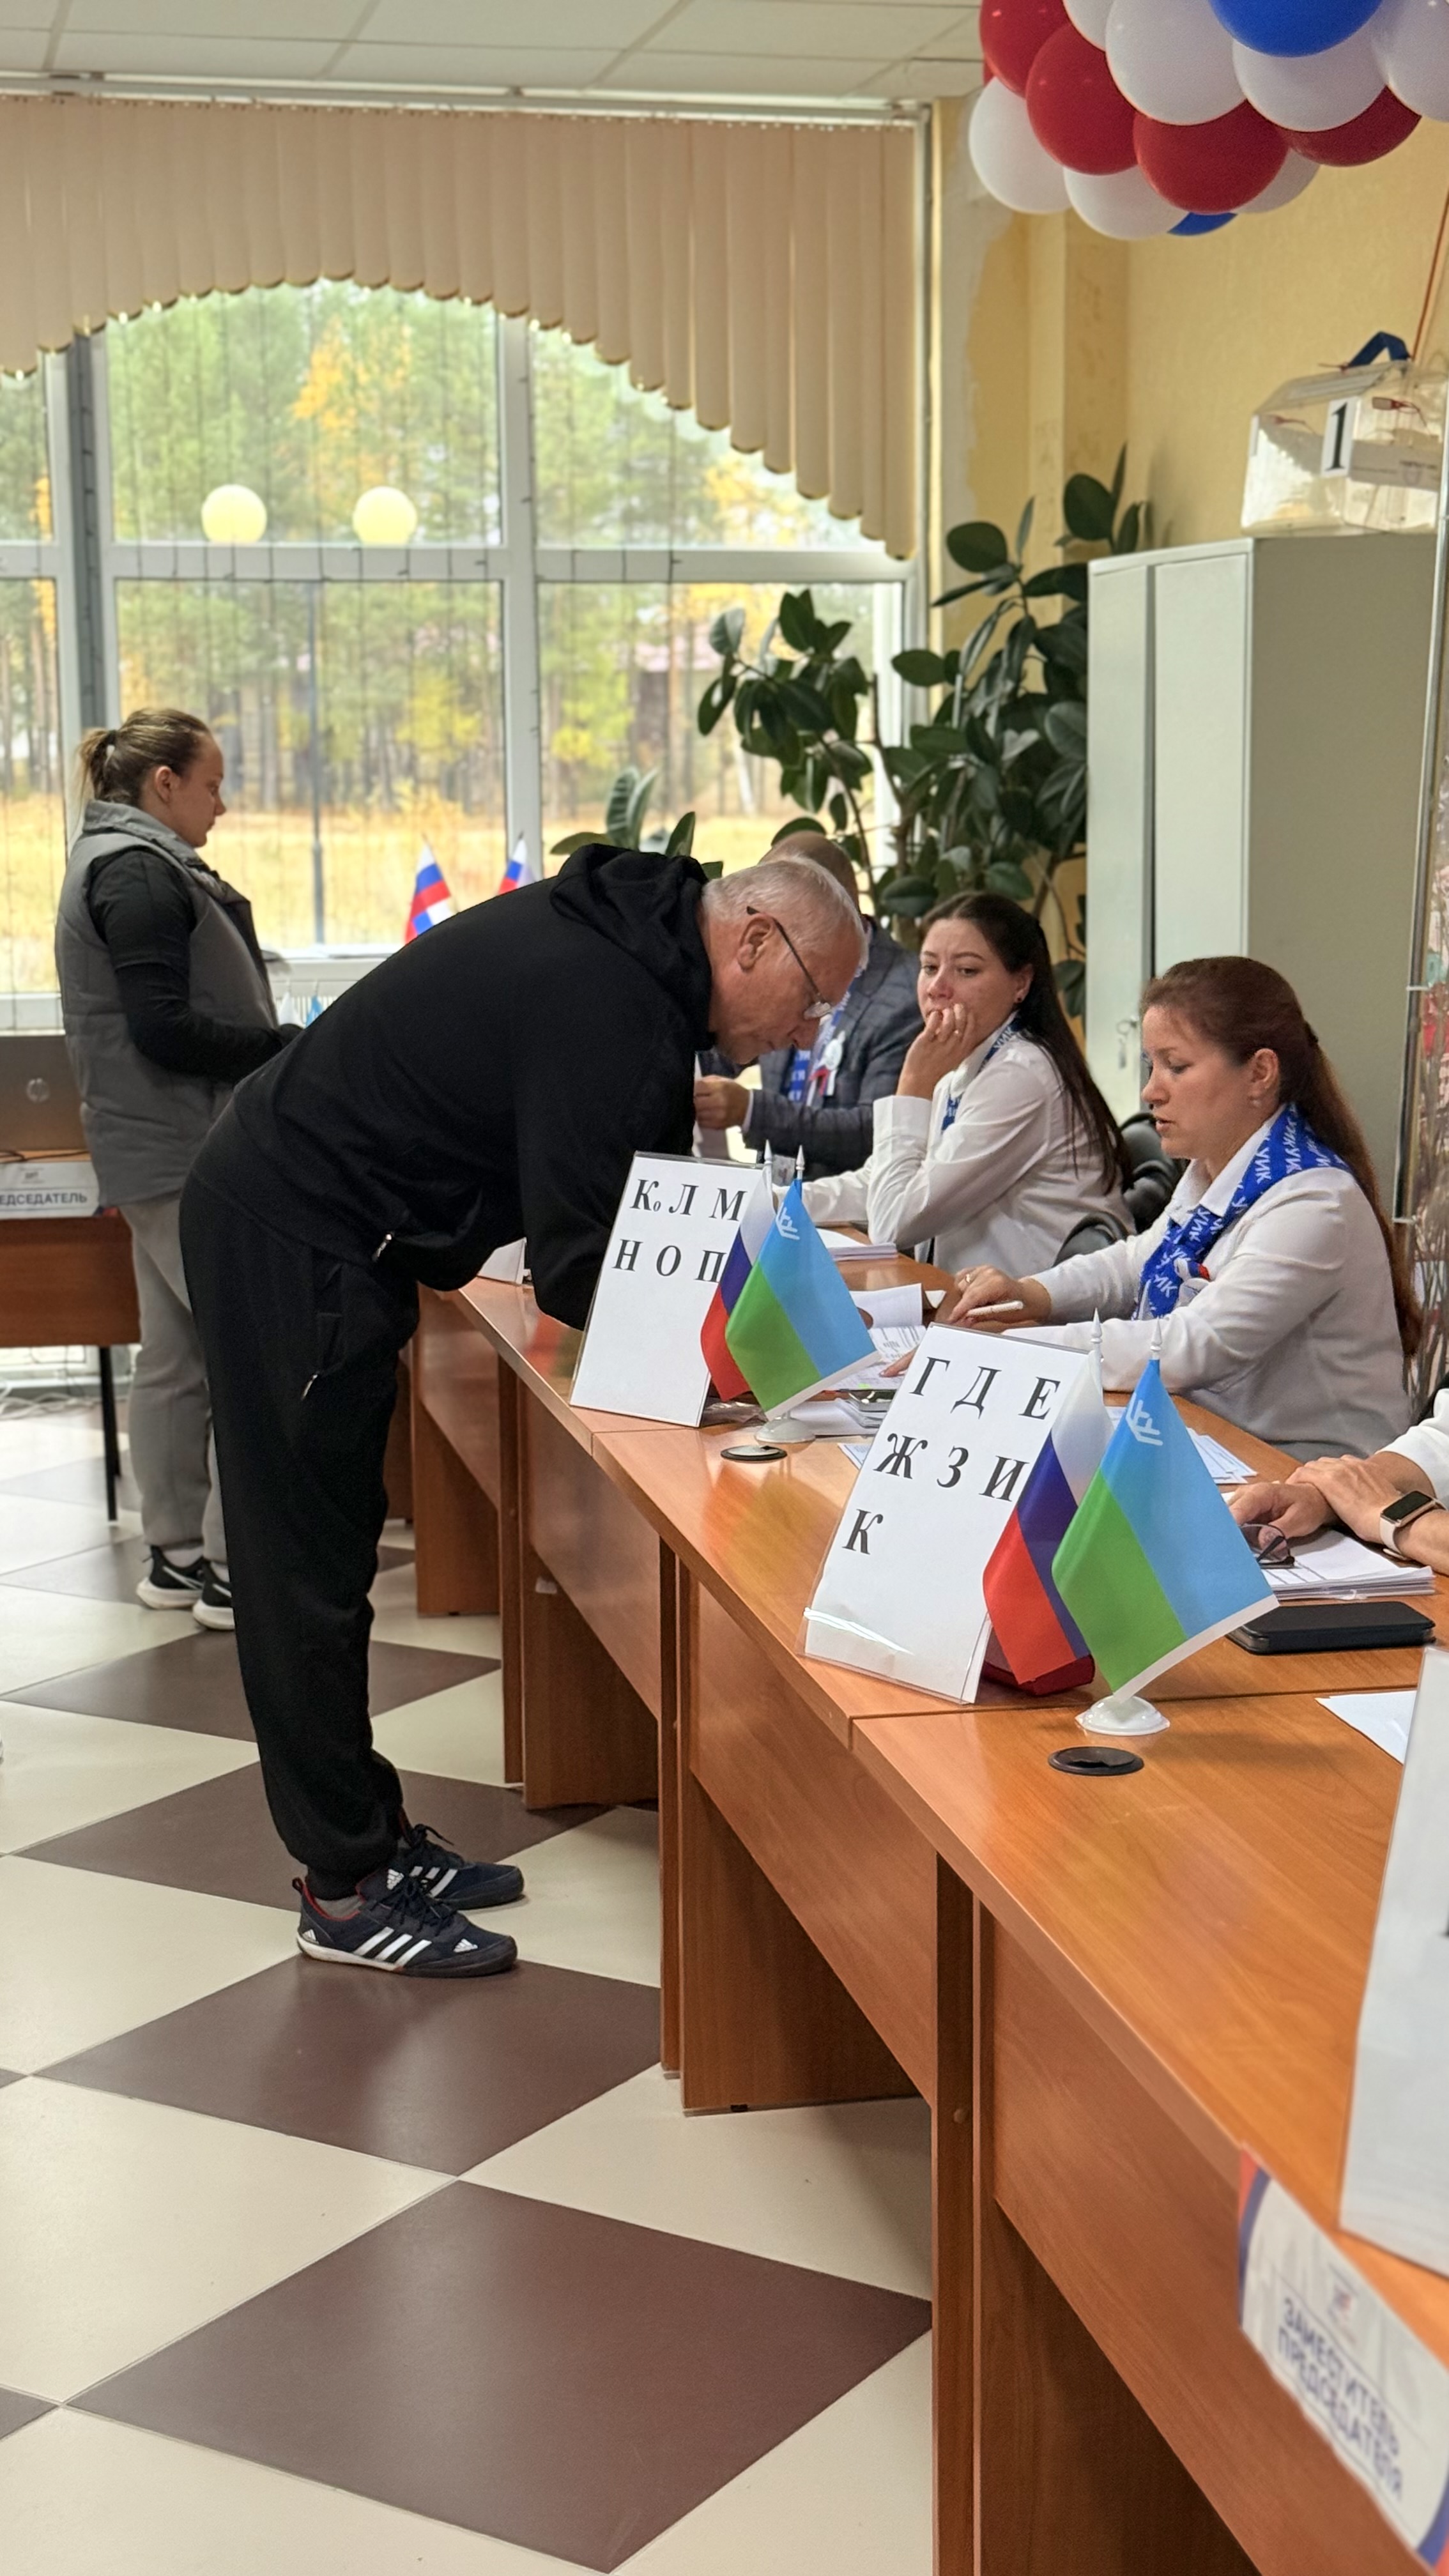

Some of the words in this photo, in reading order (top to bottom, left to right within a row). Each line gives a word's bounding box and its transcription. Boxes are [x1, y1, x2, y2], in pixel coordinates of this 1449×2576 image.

[1326, 402, 1347, 471] 1
[1255, 1147, 1272, 1184] УИК
[668, 1184, 699, 1215] Л
[709, 1188, 747, 1222] М
[1188, 1208, 1211, 1242] УИК
[611, 1239, 643, 1272] Н
[656, 1245, 682, 1276] О
[694, 1250, 726, 1283] П
[909, 1356, 951, 1397] Г
[950, 1366, 1002, 1420] Д
[1018, 1377, 1061, 1420] Е
[873, 1433, 928, 1480] Ж
[979, 1455, 1029, 1502] И
[841, 1508, 884, 1555] К
